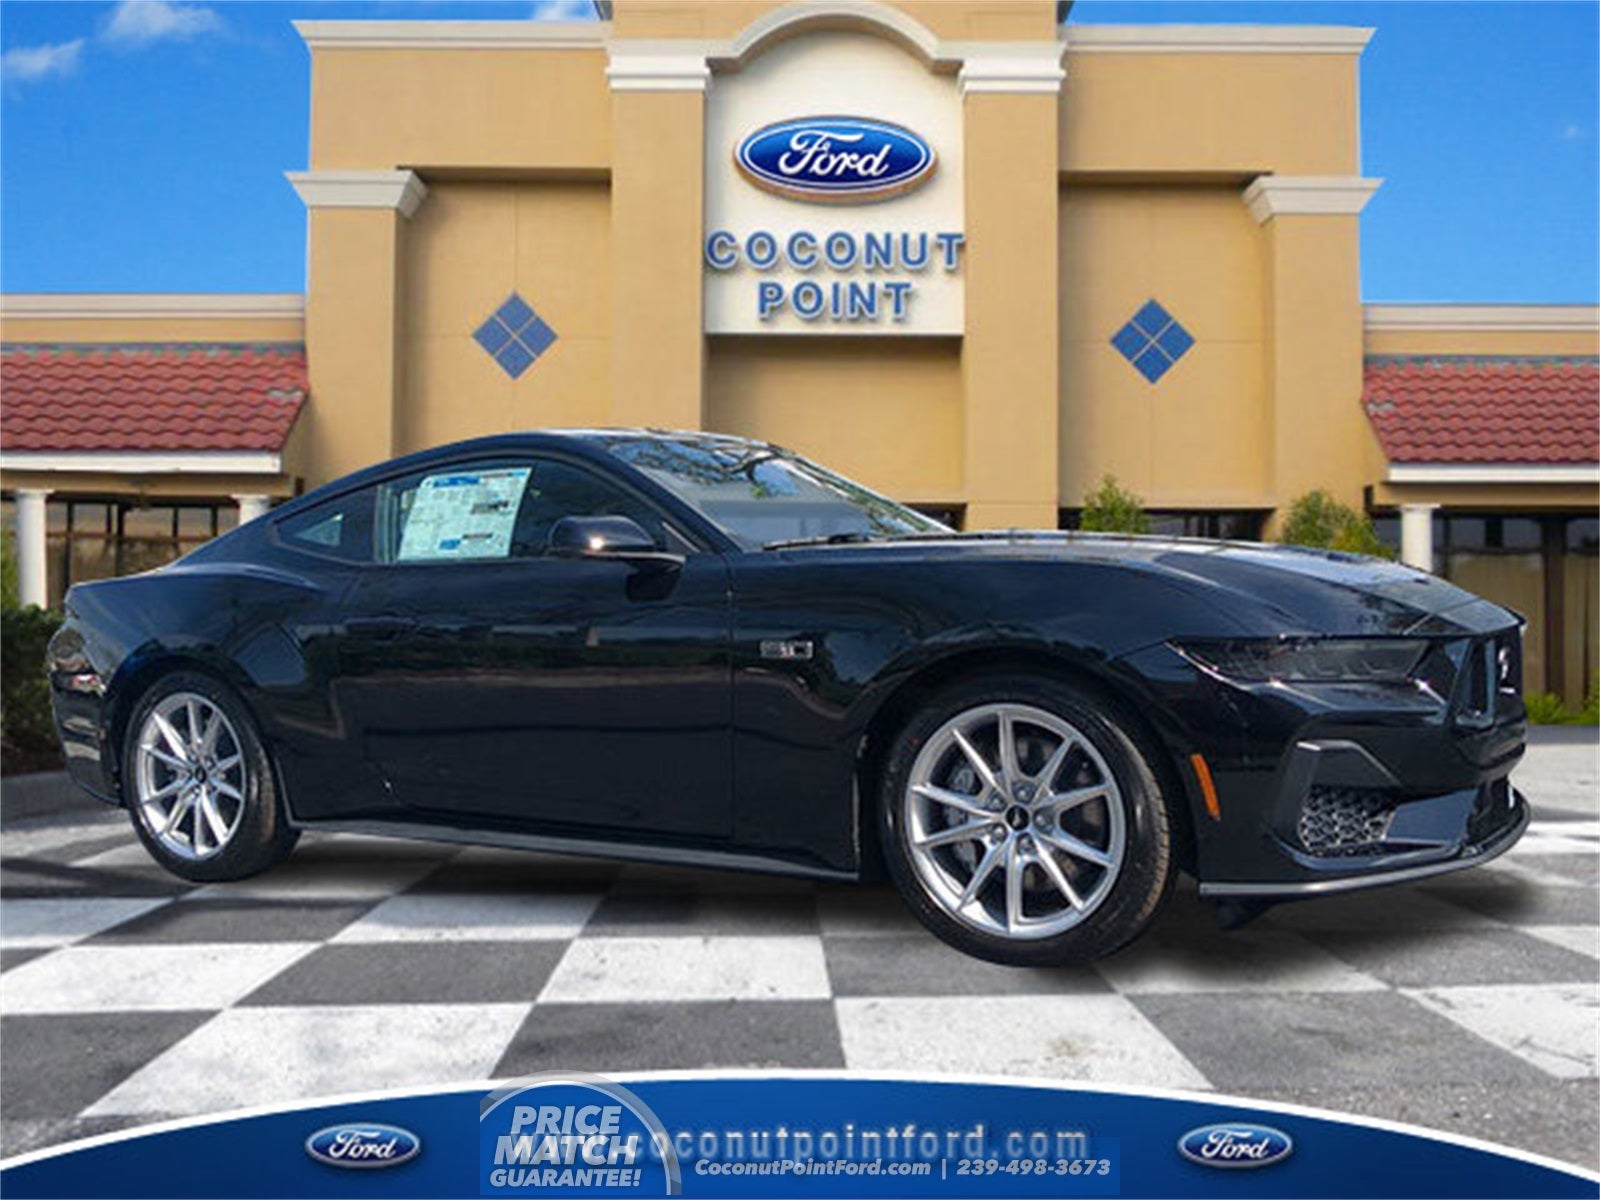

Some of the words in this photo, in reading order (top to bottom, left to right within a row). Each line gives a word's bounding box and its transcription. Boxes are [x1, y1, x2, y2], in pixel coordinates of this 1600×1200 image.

[778, 129, 892, 176] Ford
[705, 230, 965, 270] COCONUT
[757, 281, 912, 320] POINT
